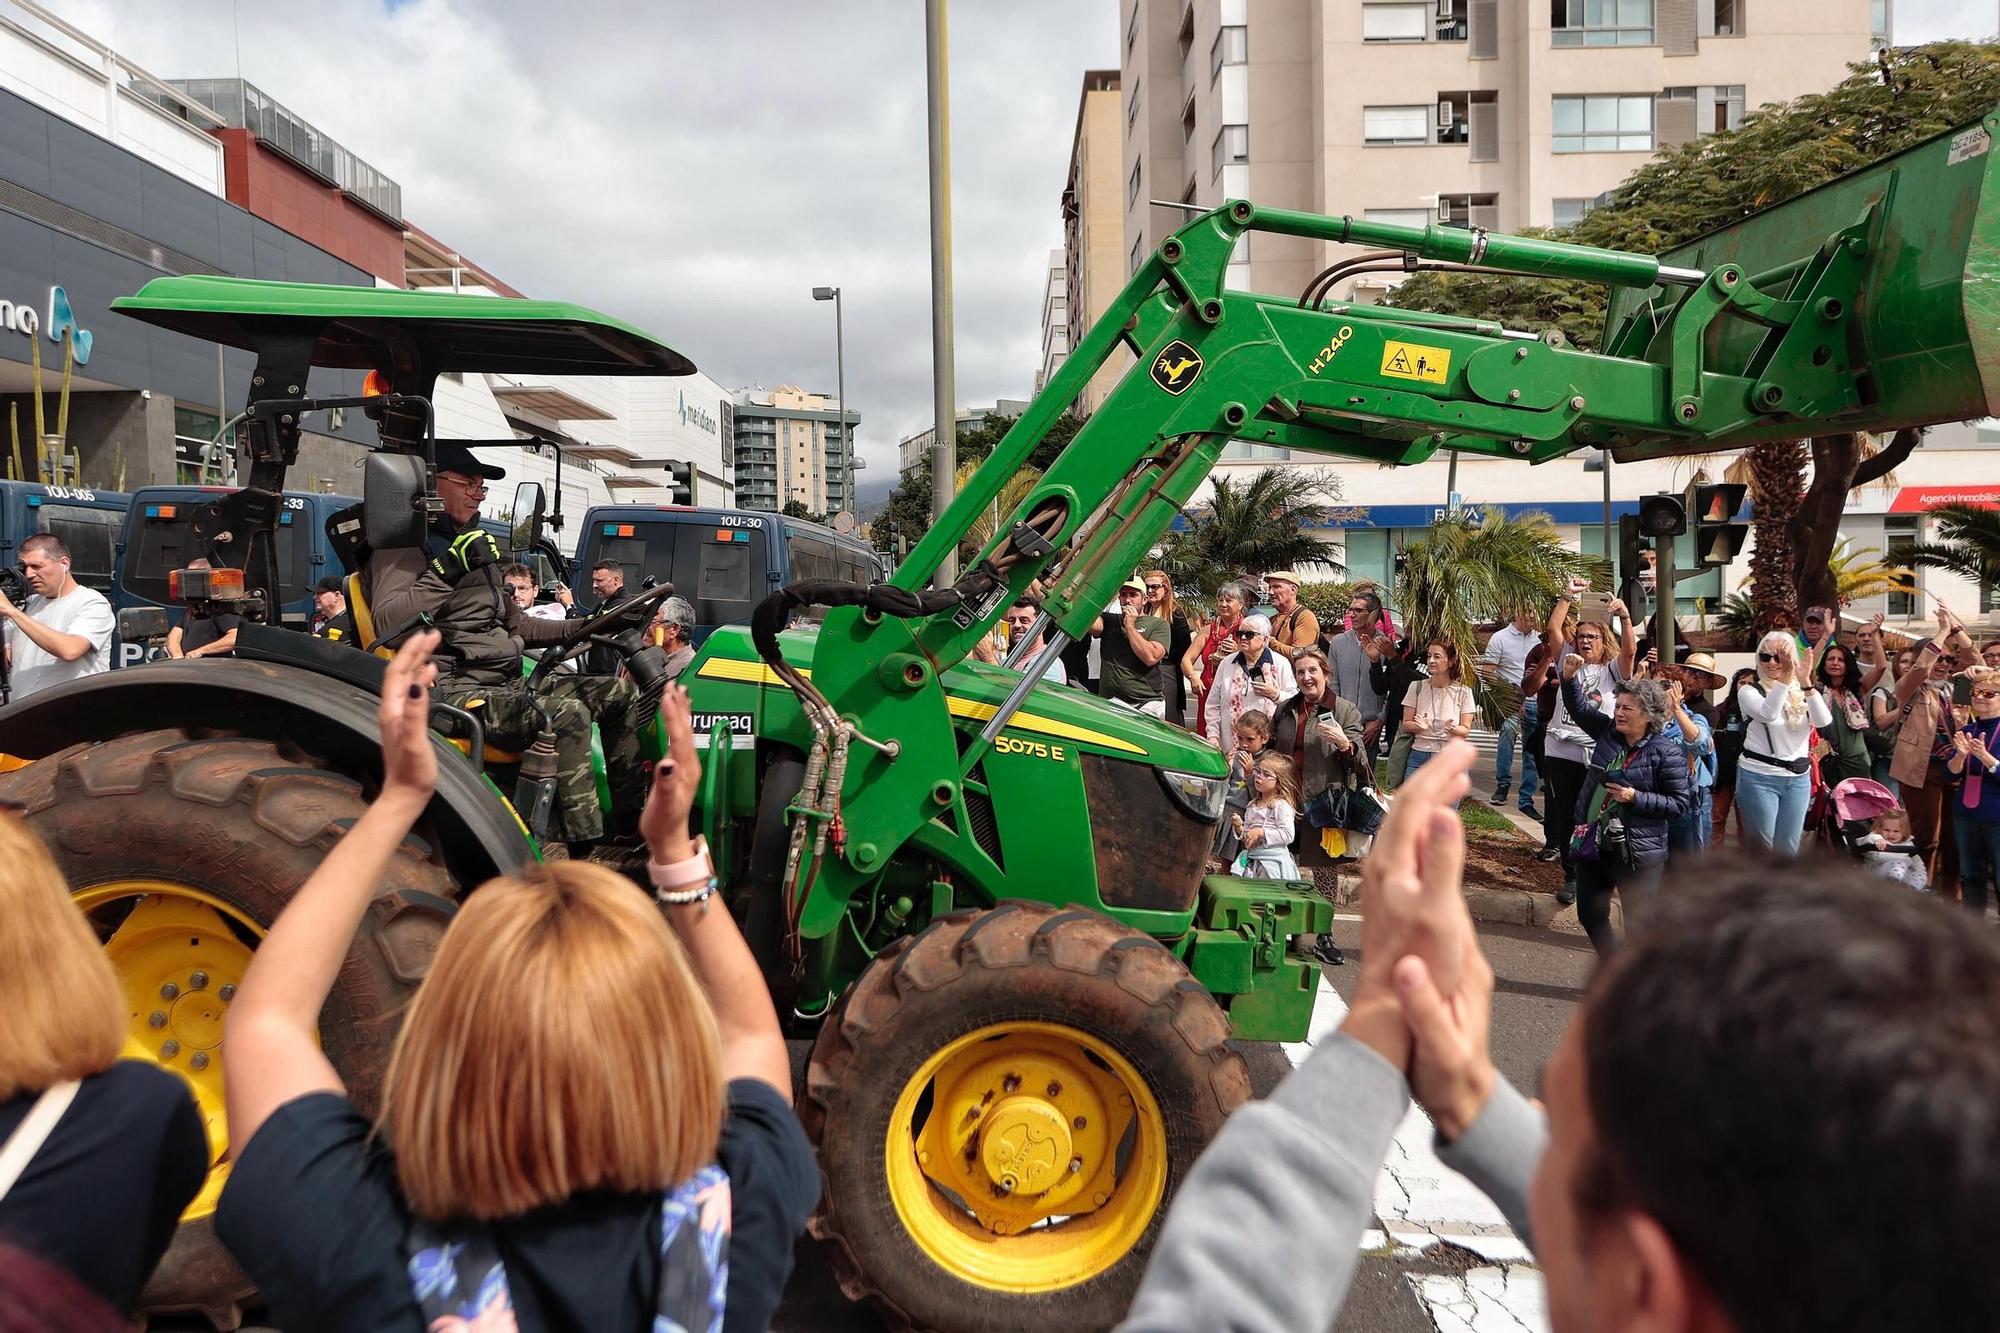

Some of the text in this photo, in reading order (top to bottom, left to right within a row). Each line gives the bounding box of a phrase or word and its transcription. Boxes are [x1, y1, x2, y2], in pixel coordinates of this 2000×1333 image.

[1920, 494, 1956, 505] Agencia
[720, 516, 762, 528] 10U-30
[994, 735, 1065, 762] 5075 E
